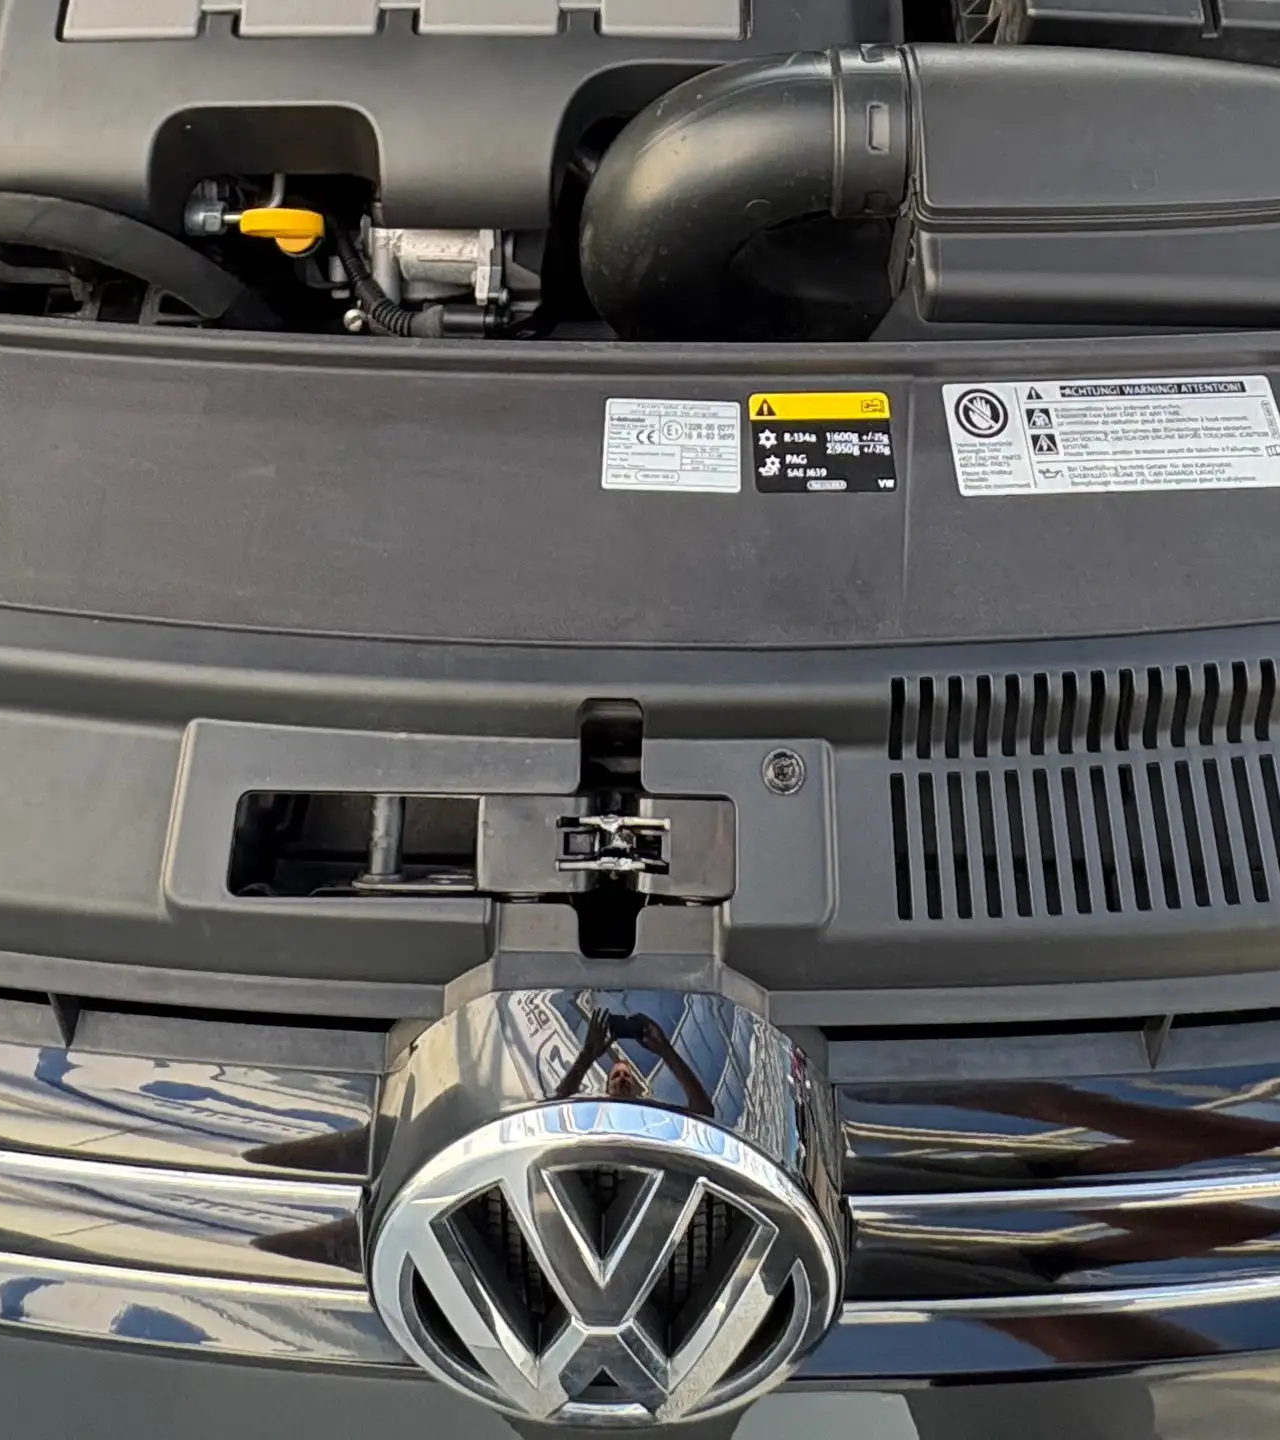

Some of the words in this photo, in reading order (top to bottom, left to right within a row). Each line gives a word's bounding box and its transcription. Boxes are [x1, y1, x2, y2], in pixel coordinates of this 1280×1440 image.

[1064, 386, 1121, 397] ACHTUNG!
[1122, 384, 1179, 395] WARNING!
[1180, 382, 1241, 393] ATTENTION!
[783, 432, 817, 443] R-134a
[834, 432, 860, 444] 600g
[834, 444, 860, 456] 950g
[785, 454, 808, 465] PAG
[787, 468, 805, 478] SAE
[878, 479, 895, 488] VW
[370, 1100, 844, 1427] VW
